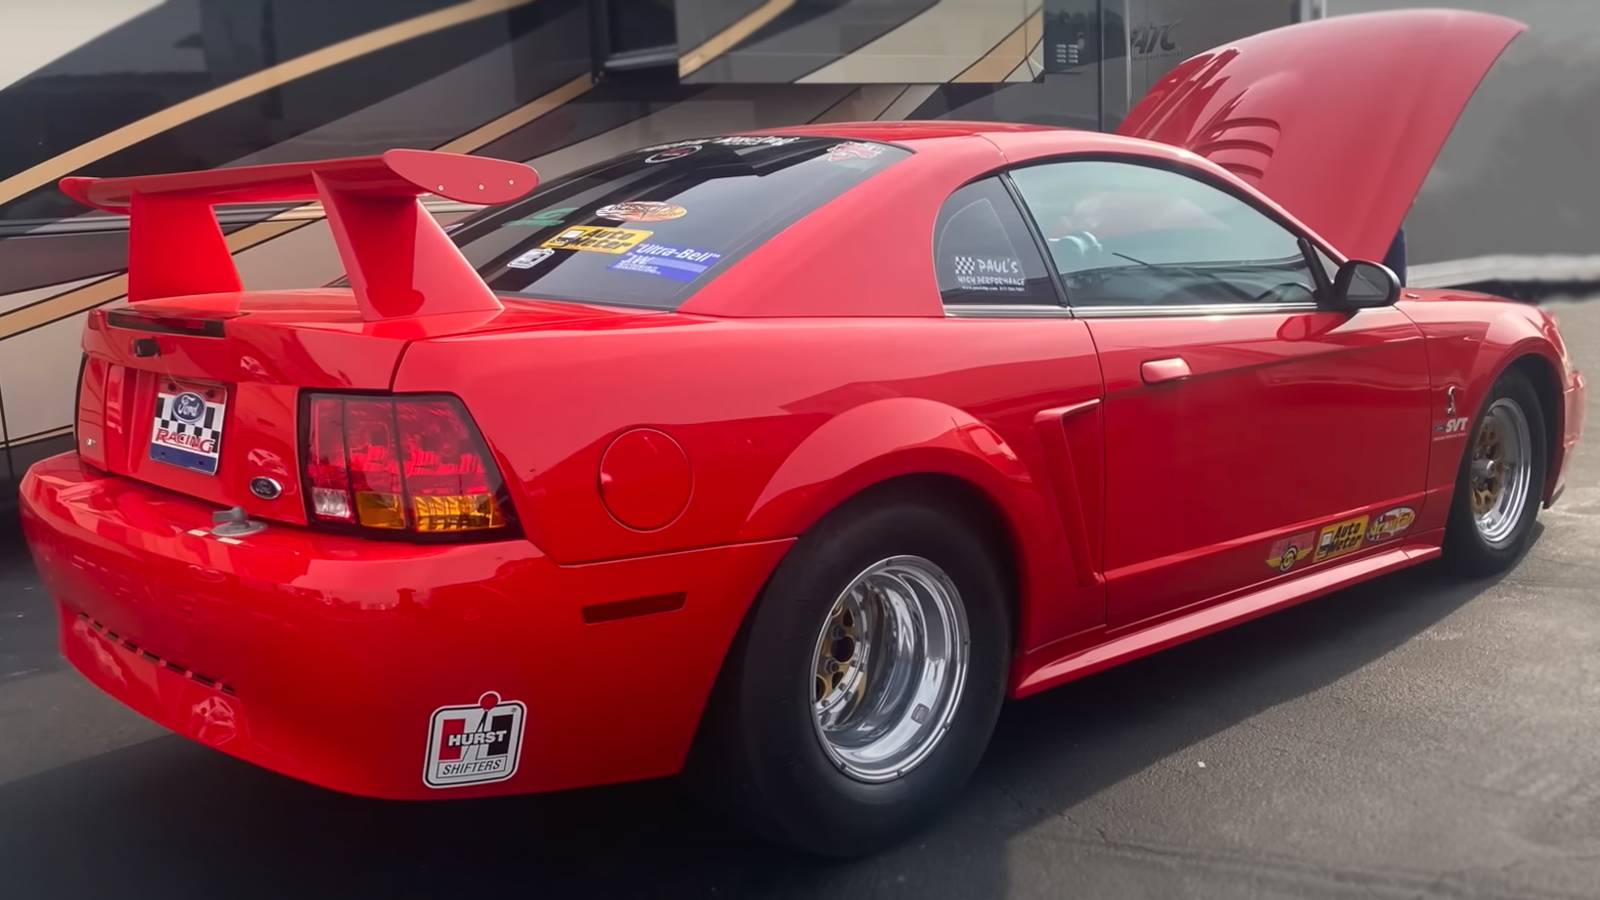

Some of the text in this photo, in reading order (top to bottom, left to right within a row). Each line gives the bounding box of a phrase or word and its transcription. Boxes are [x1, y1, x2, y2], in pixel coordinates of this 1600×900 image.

[977, 258, 1019, 274] PAUL'S
[177, 394, 201, 417] Ford
[1446, 417, 1469, 433] SVT
[156, 429, 217, 454] RACING
[1334, 522, 1362, 540] Auto
[448, 730, 508, 747] HURST
[442, 759, 502, 776] SHIFTERS
